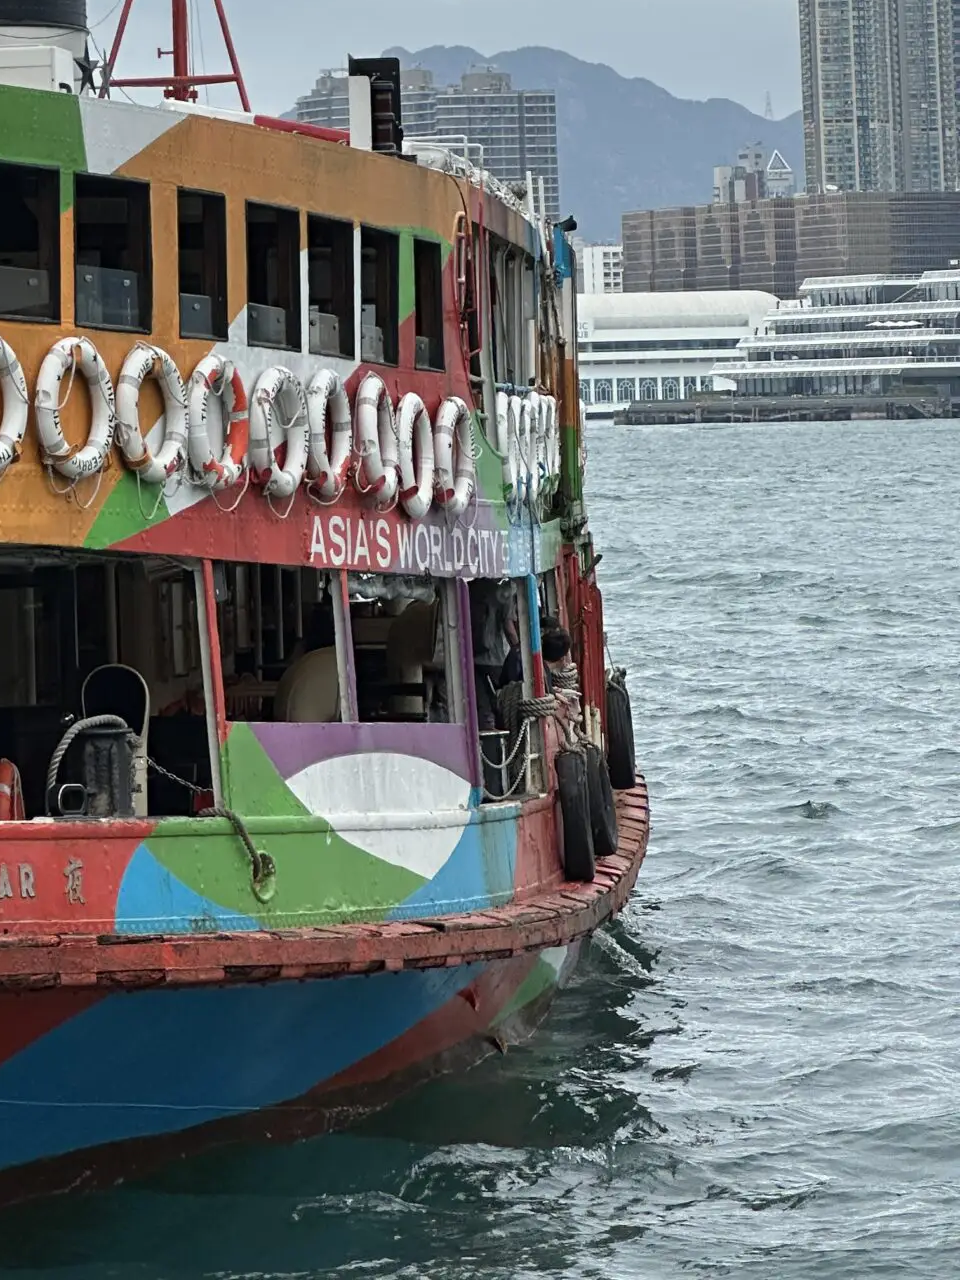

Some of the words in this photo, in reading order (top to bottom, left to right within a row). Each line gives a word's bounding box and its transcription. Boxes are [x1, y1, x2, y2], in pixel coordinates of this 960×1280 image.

[137, 358, 151, 379] THE
[76, 452, 103, 471] FERRY
[309, 515, 391, 568] ASIA'S
[396, 523, 465, 571] WORLD
[467, 527, 499, 575] CITY
[64, 858, 86, 905] 夜
